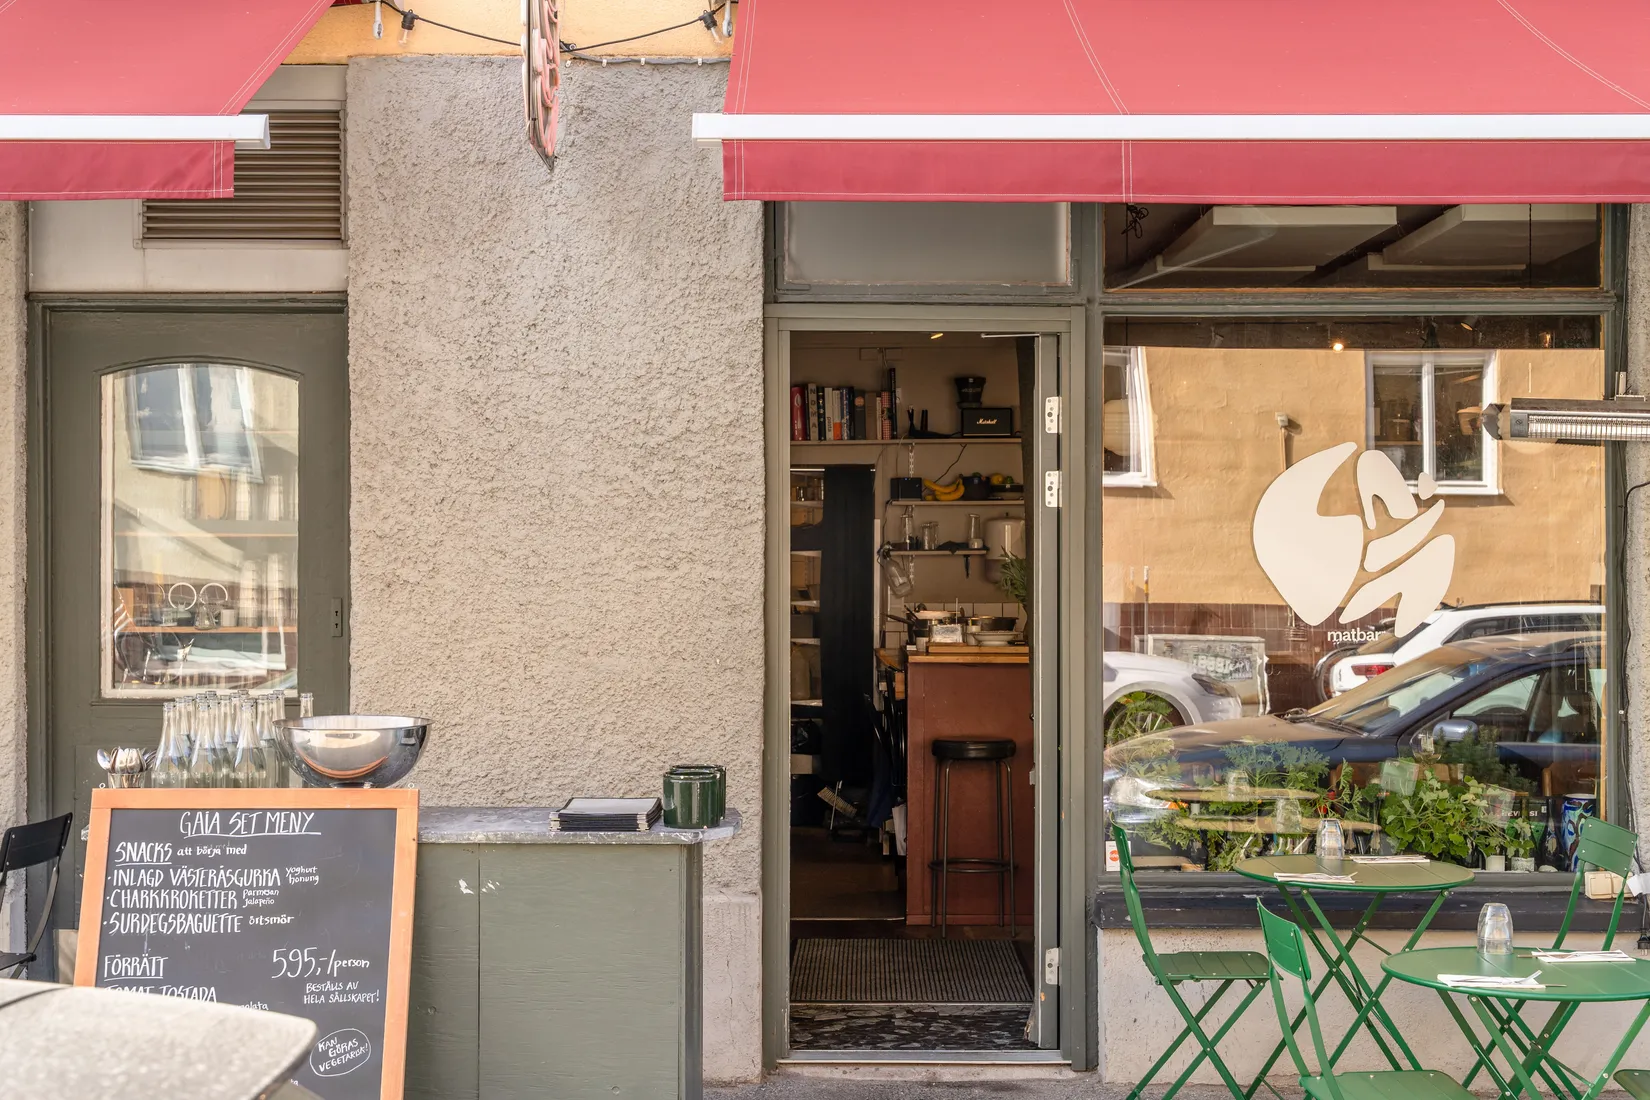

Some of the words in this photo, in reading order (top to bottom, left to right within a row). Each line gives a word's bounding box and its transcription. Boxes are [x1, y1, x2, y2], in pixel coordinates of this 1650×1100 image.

[1327, 627, 1380, 642] matbar
[229, 811, 262, 835] SET
[265, 811, 315, 834] MENY
[115, 842, 173, 862] SNACKS
[177, 846, 193, 856] att
[196, 844, 222, 858] börja
[226, 844, 247, 856] med
[113, 867, 164, 887] INLAGD
[170, 865, 281, 887] VÄSTERÅSGURKA
[285, 865, 318, 877] yoghurt
[288, 873, 320, 885] honung
[110, 888, 238, 909] CHARKKROKETTER
[108, 912, 243, 934] SURDEGSBAGUETTE
[104, 954, 168, 977] FÖRRÄTT
[345, 981, 359, 991] AV
[303, 993, 326, 1004] HELA
[318, 1036, 338, 1052] KAN
[328, 1038, 359, 1057] GÖRAS
